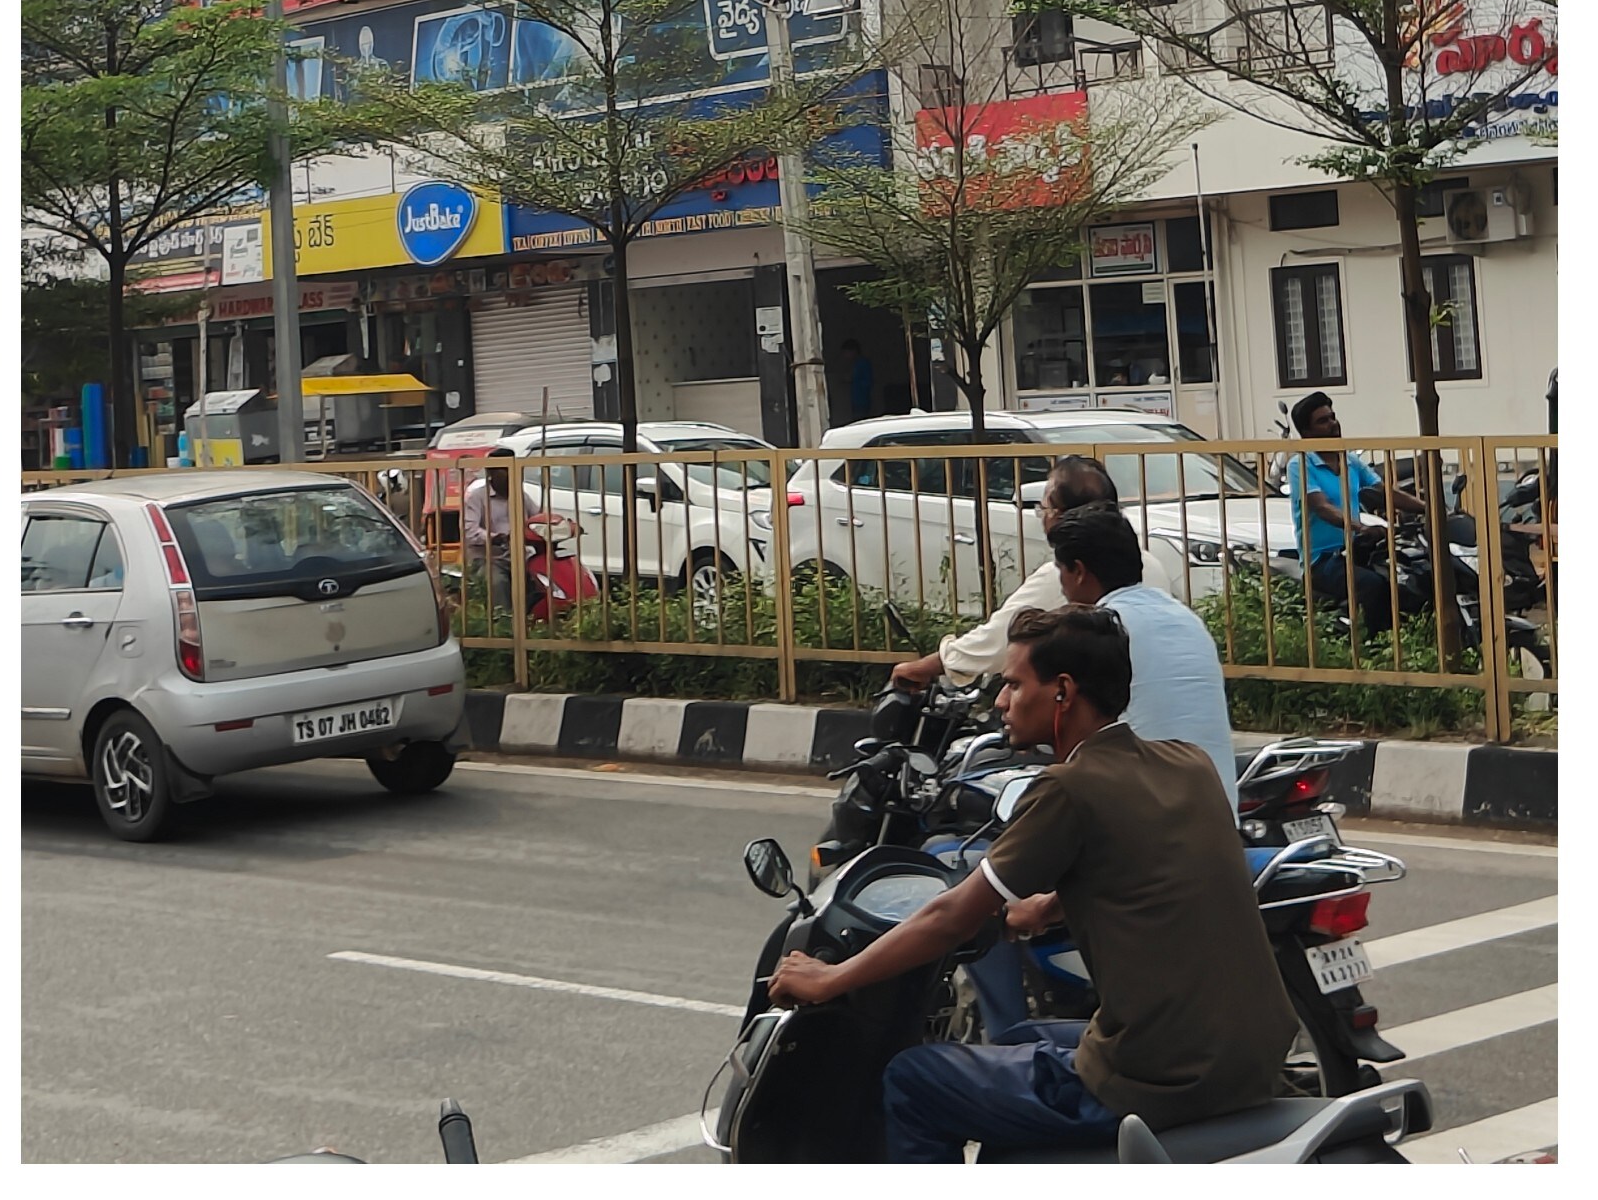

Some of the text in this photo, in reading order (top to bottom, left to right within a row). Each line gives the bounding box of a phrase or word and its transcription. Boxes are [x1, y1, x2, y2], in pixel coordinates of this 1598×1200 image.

[404, 202, 461, 235] JustBake
[218, 295, 275, 318] HARDWAR
[296, 721, 314, 741] TS
[318, 717, 333, 736] 07
[339, 713, 356, 734] JH
